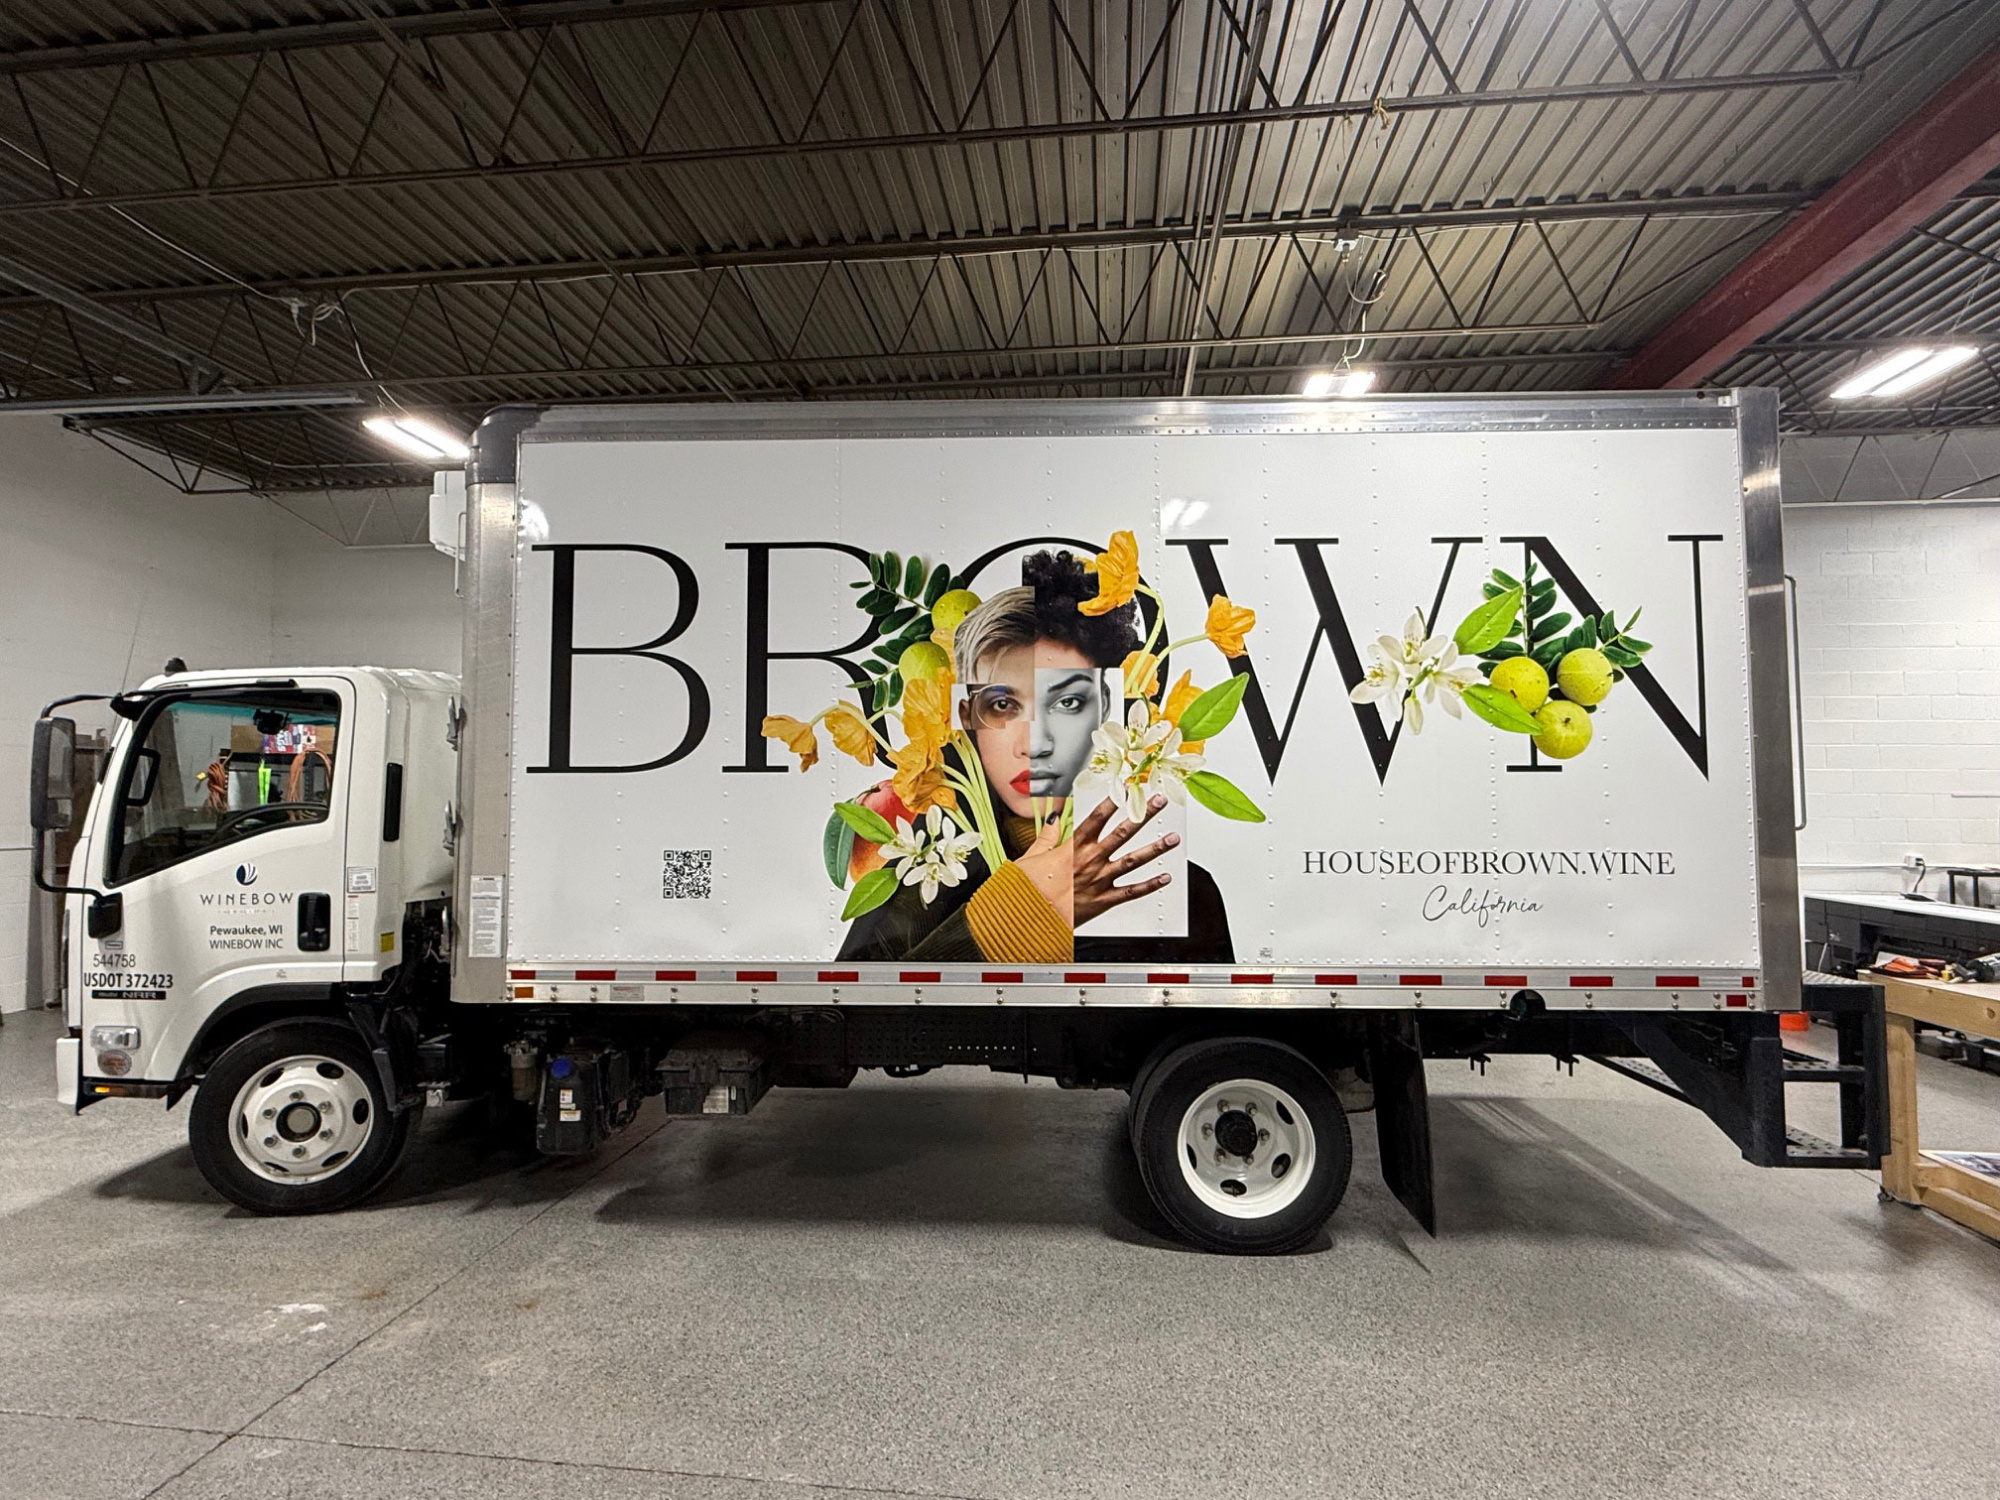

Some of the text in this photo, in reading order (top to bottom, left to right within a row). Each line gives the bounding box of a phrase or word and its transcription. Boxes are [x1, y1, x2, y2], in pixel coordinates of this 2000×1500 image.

[1304, 851, 1675, 875] HOUSEOFBROWN.WINE
[200, 892, 293, 906] WINEBOW
[1422, 885, 1543, 928] California
[210, 924, 283, 937] Pewaukee, WI
[209, 938, 283, 950] WINEBOW INC
[93, 953, 136, 968] 544758
[84, 972, 174, 989] USDOT 372423
